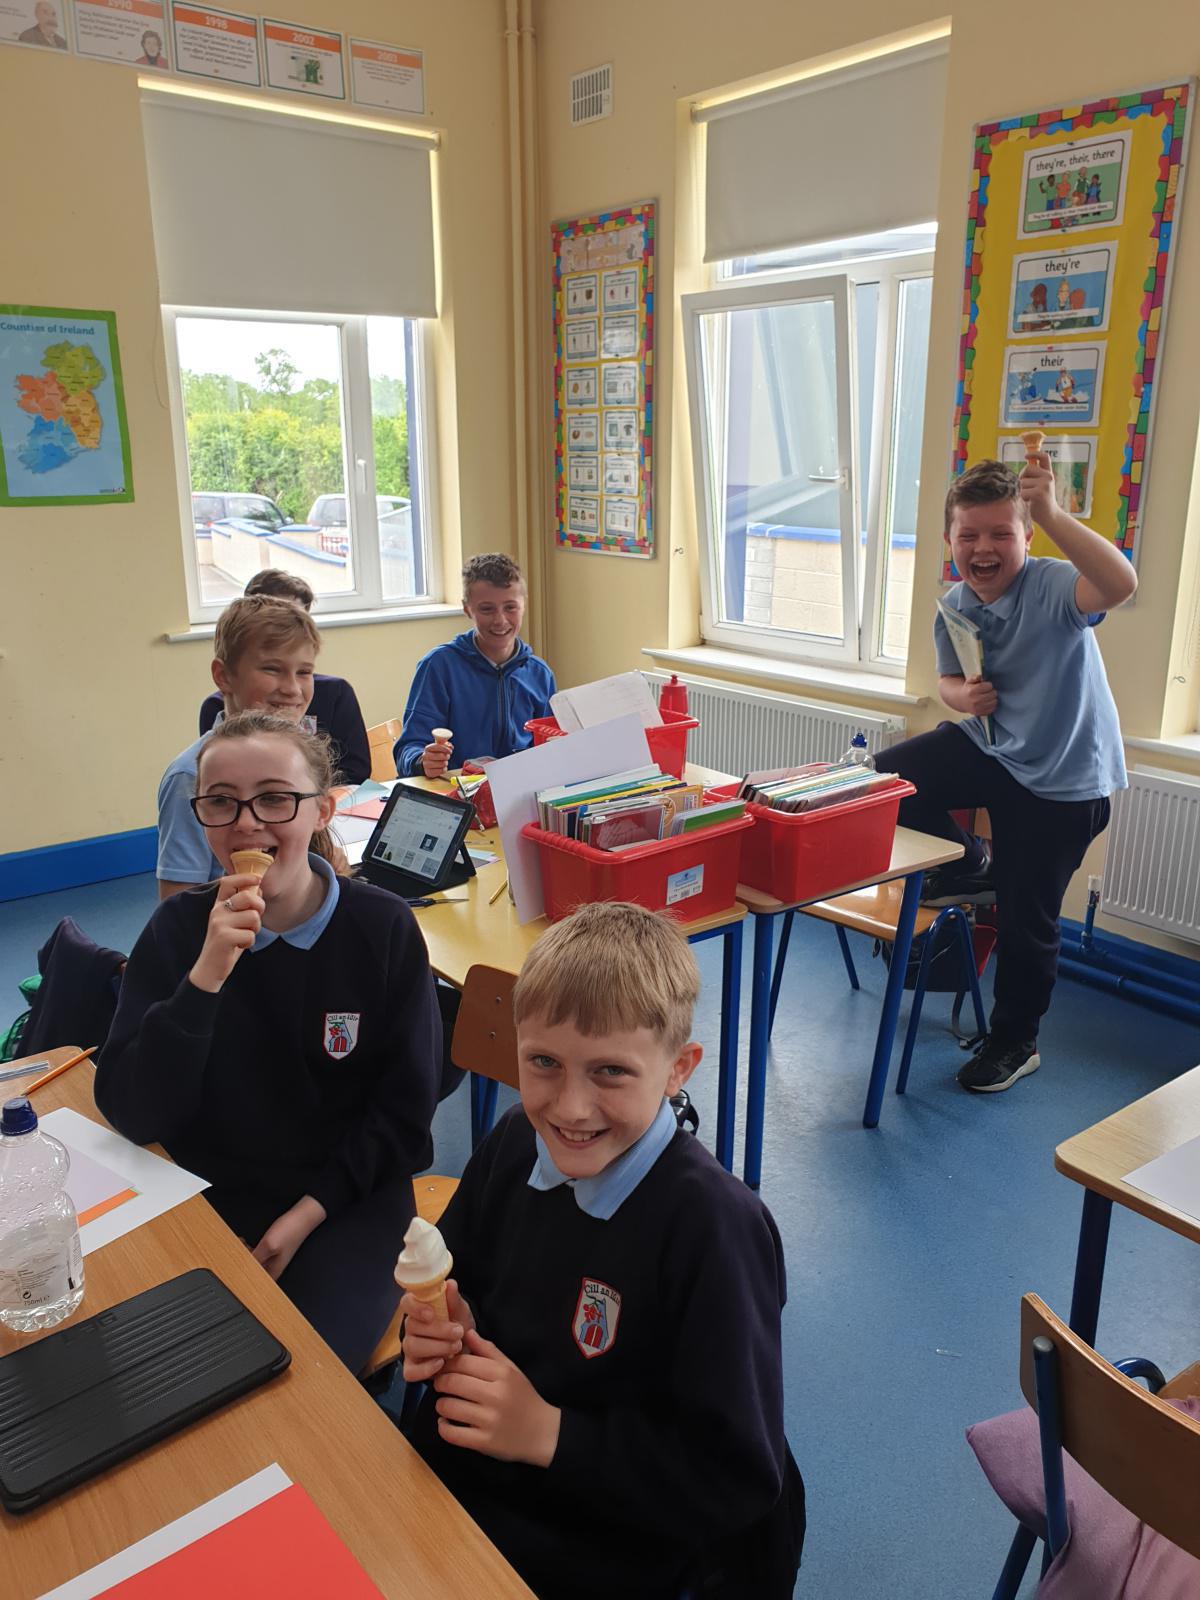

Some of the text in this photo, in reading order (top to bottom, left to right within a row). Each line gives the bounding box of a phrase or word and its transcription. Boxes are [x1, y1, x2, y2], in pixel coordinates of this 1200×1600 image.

[1036, 149, 1115, 172] they're, their, there
[1045, 258, 1081, 274] they're
[0, 322, 95, 335] Counties of Ireland
[1040, 355, 1064, 367] their
[585, 1284, 599, 1294] Cill
